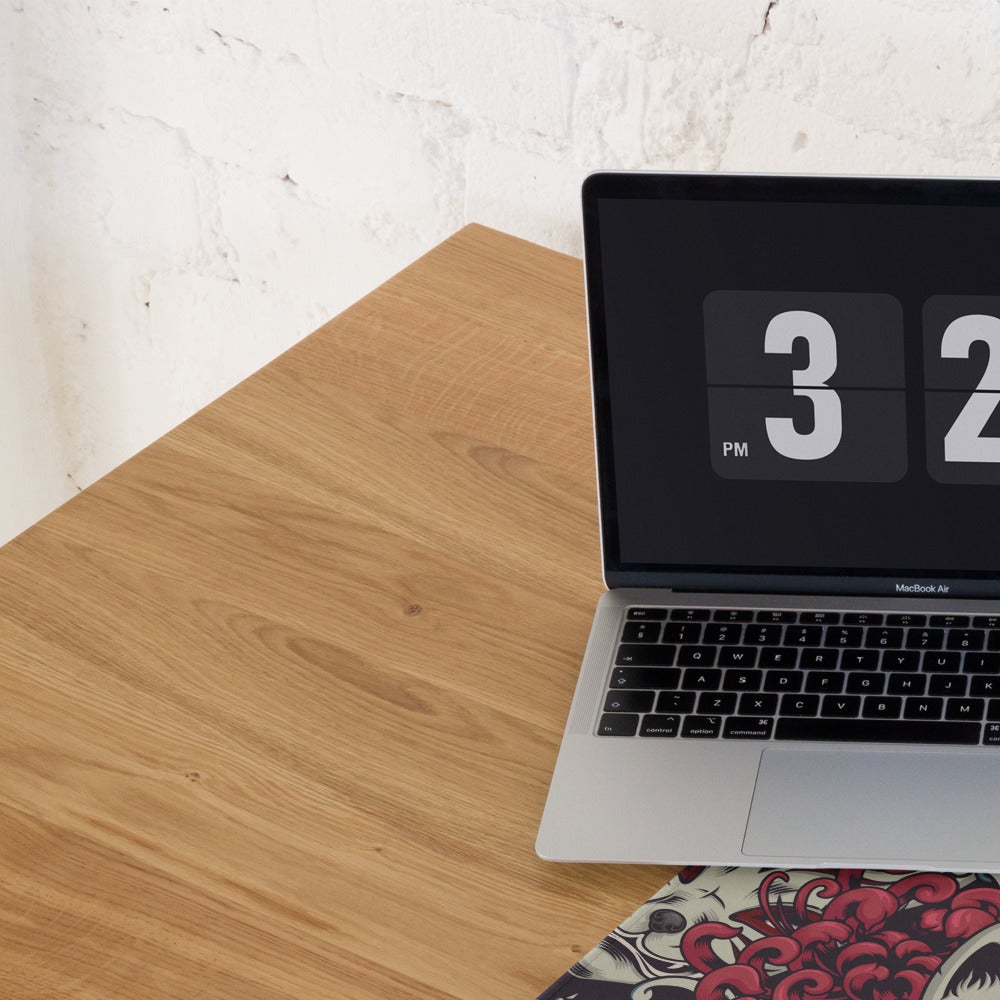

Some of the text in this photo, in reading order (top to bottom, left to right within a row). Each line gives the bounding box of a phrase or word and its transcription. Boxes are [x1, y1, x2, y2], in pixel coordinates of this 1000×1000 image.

[764, 310, 843, 460] 3
[722, 441, 749, 457] PM
[895, 584, 950, 593] MacBook Air
[693, 652, 701, 660] Q
